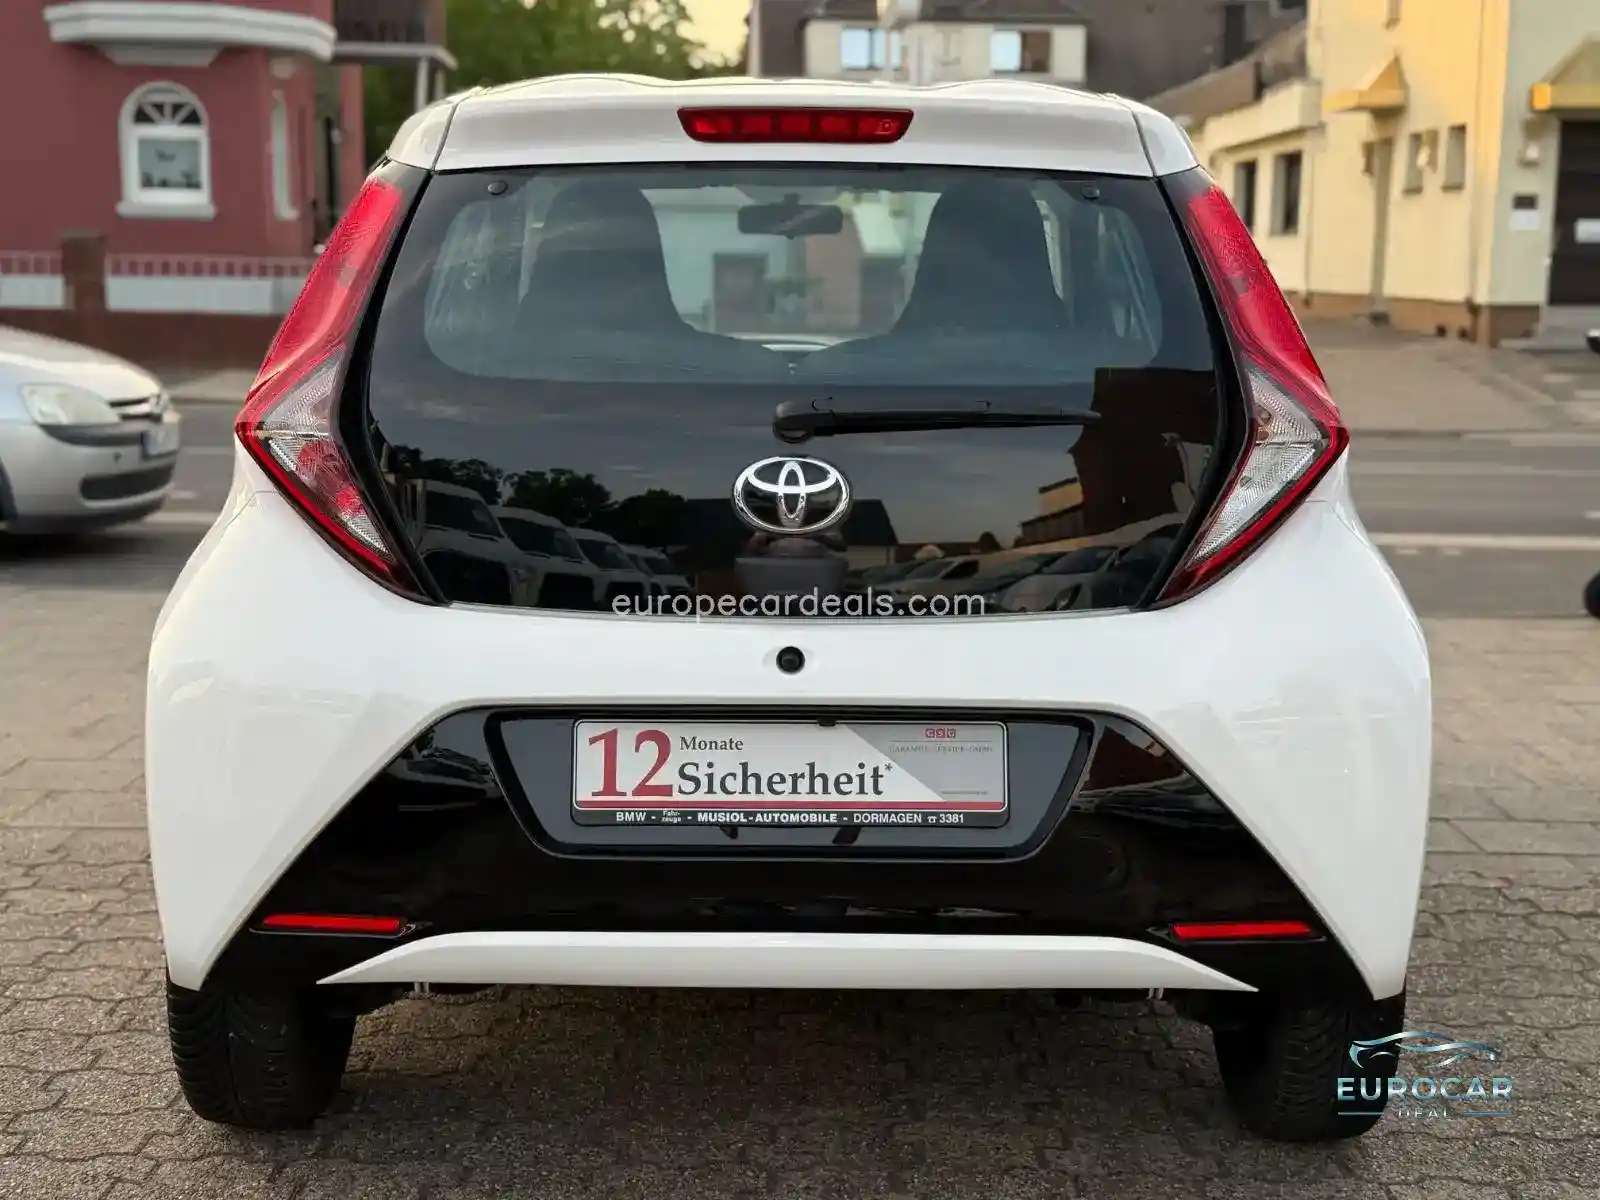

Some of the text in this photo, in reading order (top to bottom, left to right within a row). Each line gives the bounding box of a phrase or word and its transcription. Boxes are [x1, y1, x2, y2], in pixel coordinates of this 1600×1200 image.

[679, 736, 744, 751] Monate
[588, 728, 673, 797] 12
[616, 812, 646, 822] BMW
[853, 813, 921, 824] DORMAGEN
[939, 813, 964, 824] 3381
